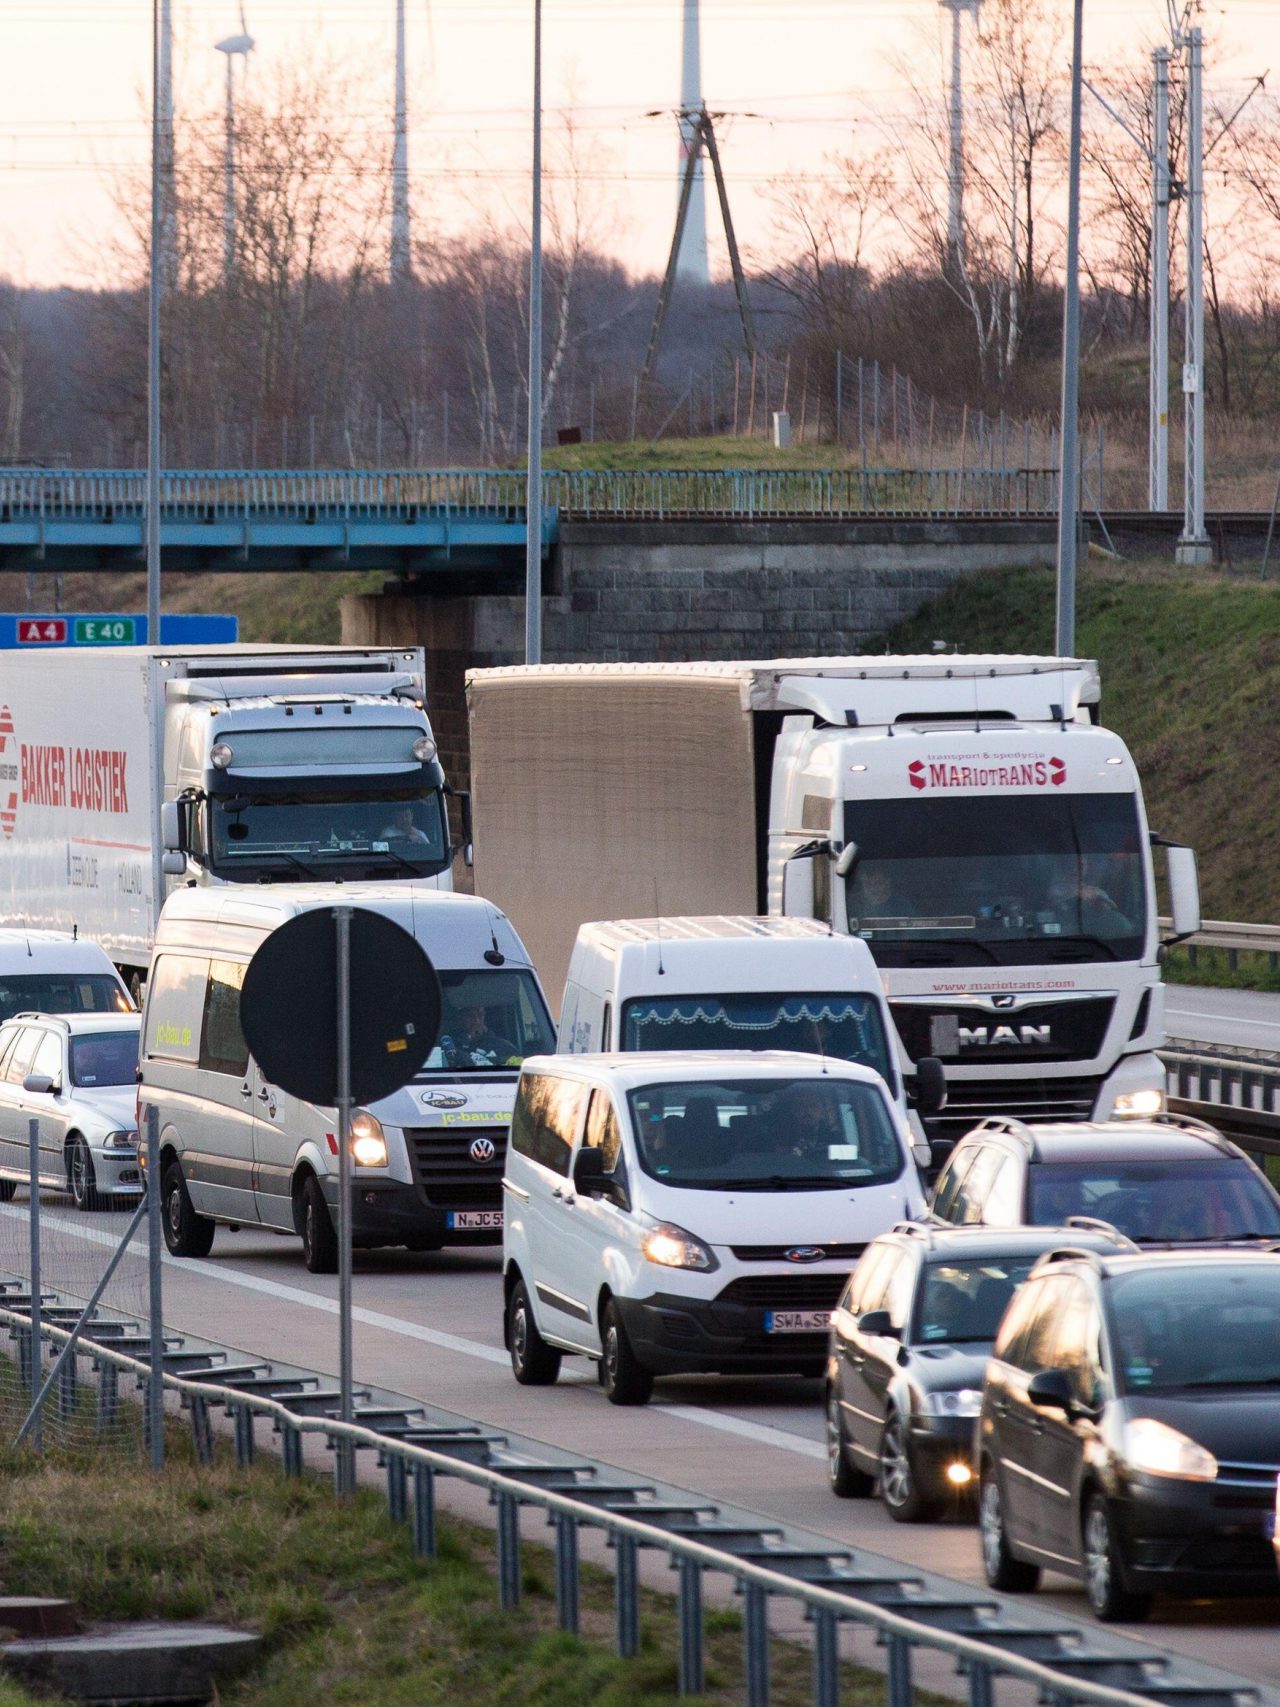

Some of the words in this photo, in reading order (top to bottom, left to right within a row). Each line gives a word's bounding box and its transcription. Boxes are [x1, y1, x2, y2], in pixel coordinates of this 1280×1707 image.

[927, 753, 980, 761] transport
[20, 743, 67, 807] BAKKER
[69, 746, 129, 814] LOGISTIEK
[928, 761, 1048, 788] MARIOTRANS
[931, 979, 1075, 992] www.mariotrans.com
[958, 1025, 1051, 1046] MAN
[441, 1112, 512, 1125] jc-bau.de
